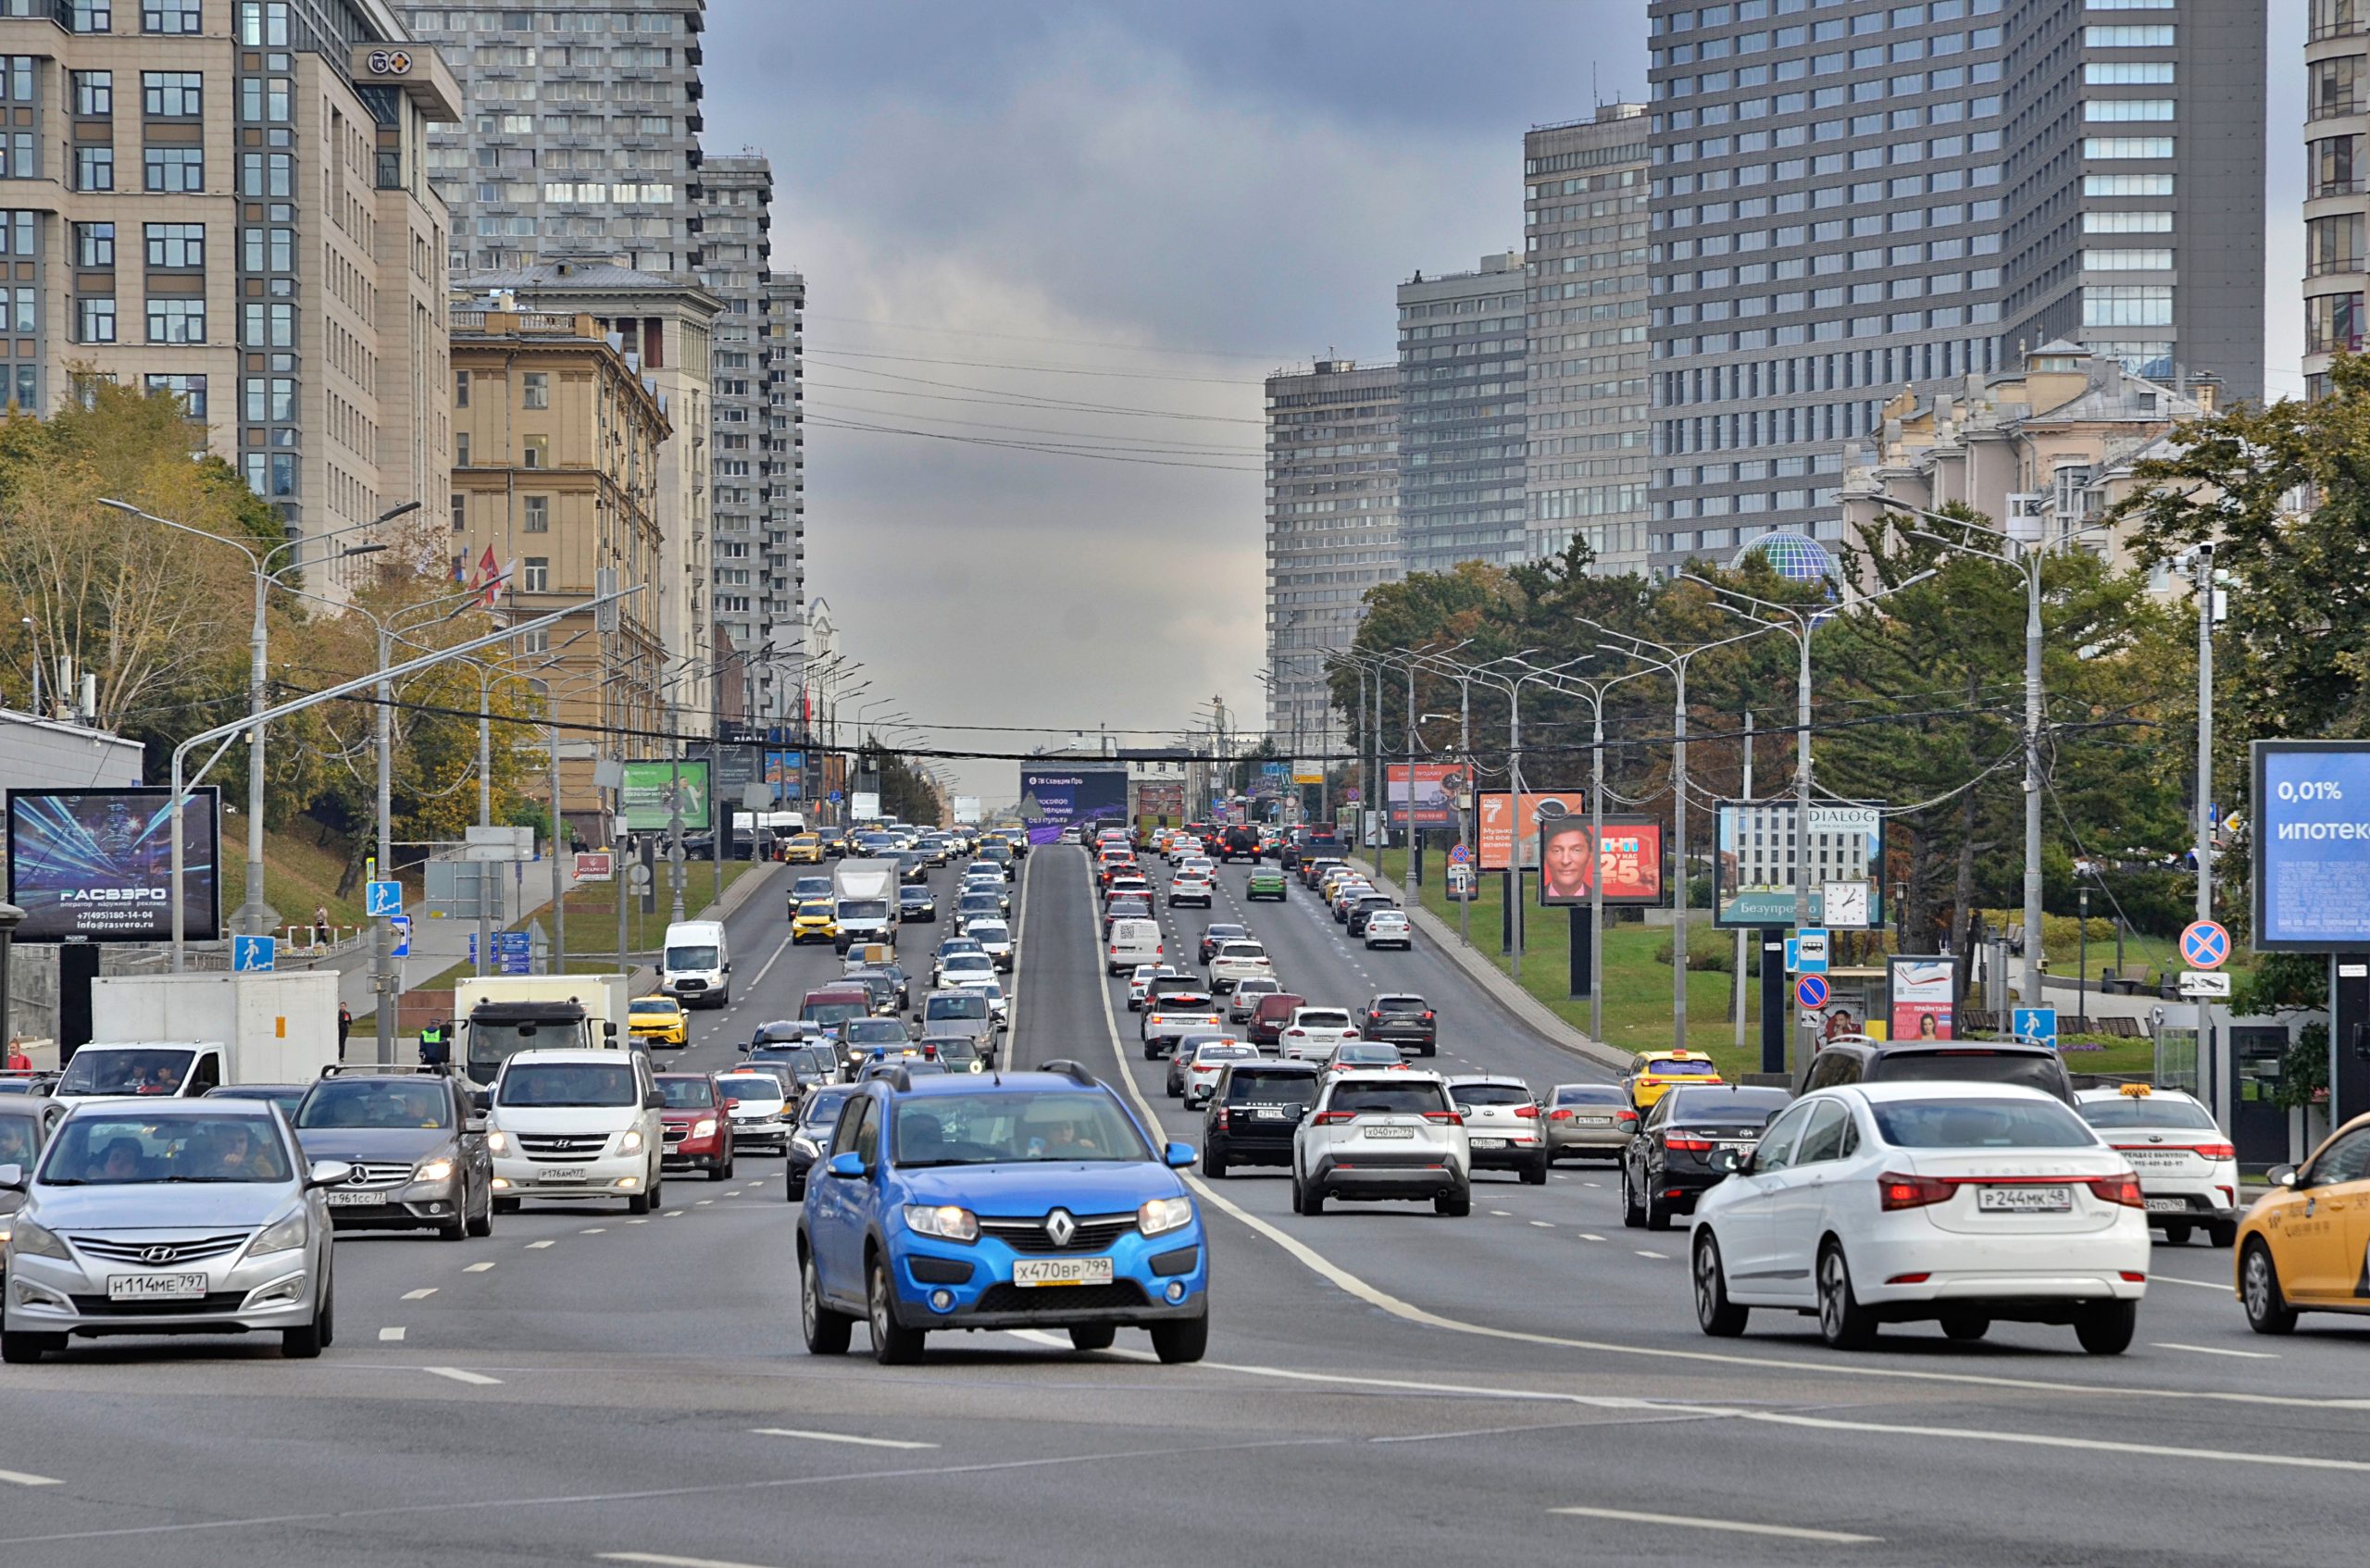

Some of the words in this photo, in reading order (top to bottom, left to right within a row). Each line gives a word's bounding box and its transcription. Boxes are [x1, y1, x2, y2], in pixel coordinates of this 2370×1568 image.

[2277, 781, 2342, 803] 0,01%
[1483, 803, 1502, 823] 7
[1809, 810, 1875, 822] DIALOG
[2278, 822, 2370, 840] ипотек
[1600, 853, 1640, 884] 25
[60, 889, 167, 901] РАСВЭРО
[77, 911, 154, 920] +7(495)180-14-04
[1740, 902, 1816, 915] Безупрео
[77, 921, 155, 929] info@rasvero.ru
[332, 1194, 370, 1202] Т961СС
[1986, 1191, 2045, 1205] Р244МК
[2050, 1190, 2064, 1201] 48
[1019, 1263, 1080, 1279] Х470ВР
[1085, 1260, 1108, 1272] 799
[114, 1277, 175, 1292] Н114МЕ
[179, 1275, 203, 1288] 797
